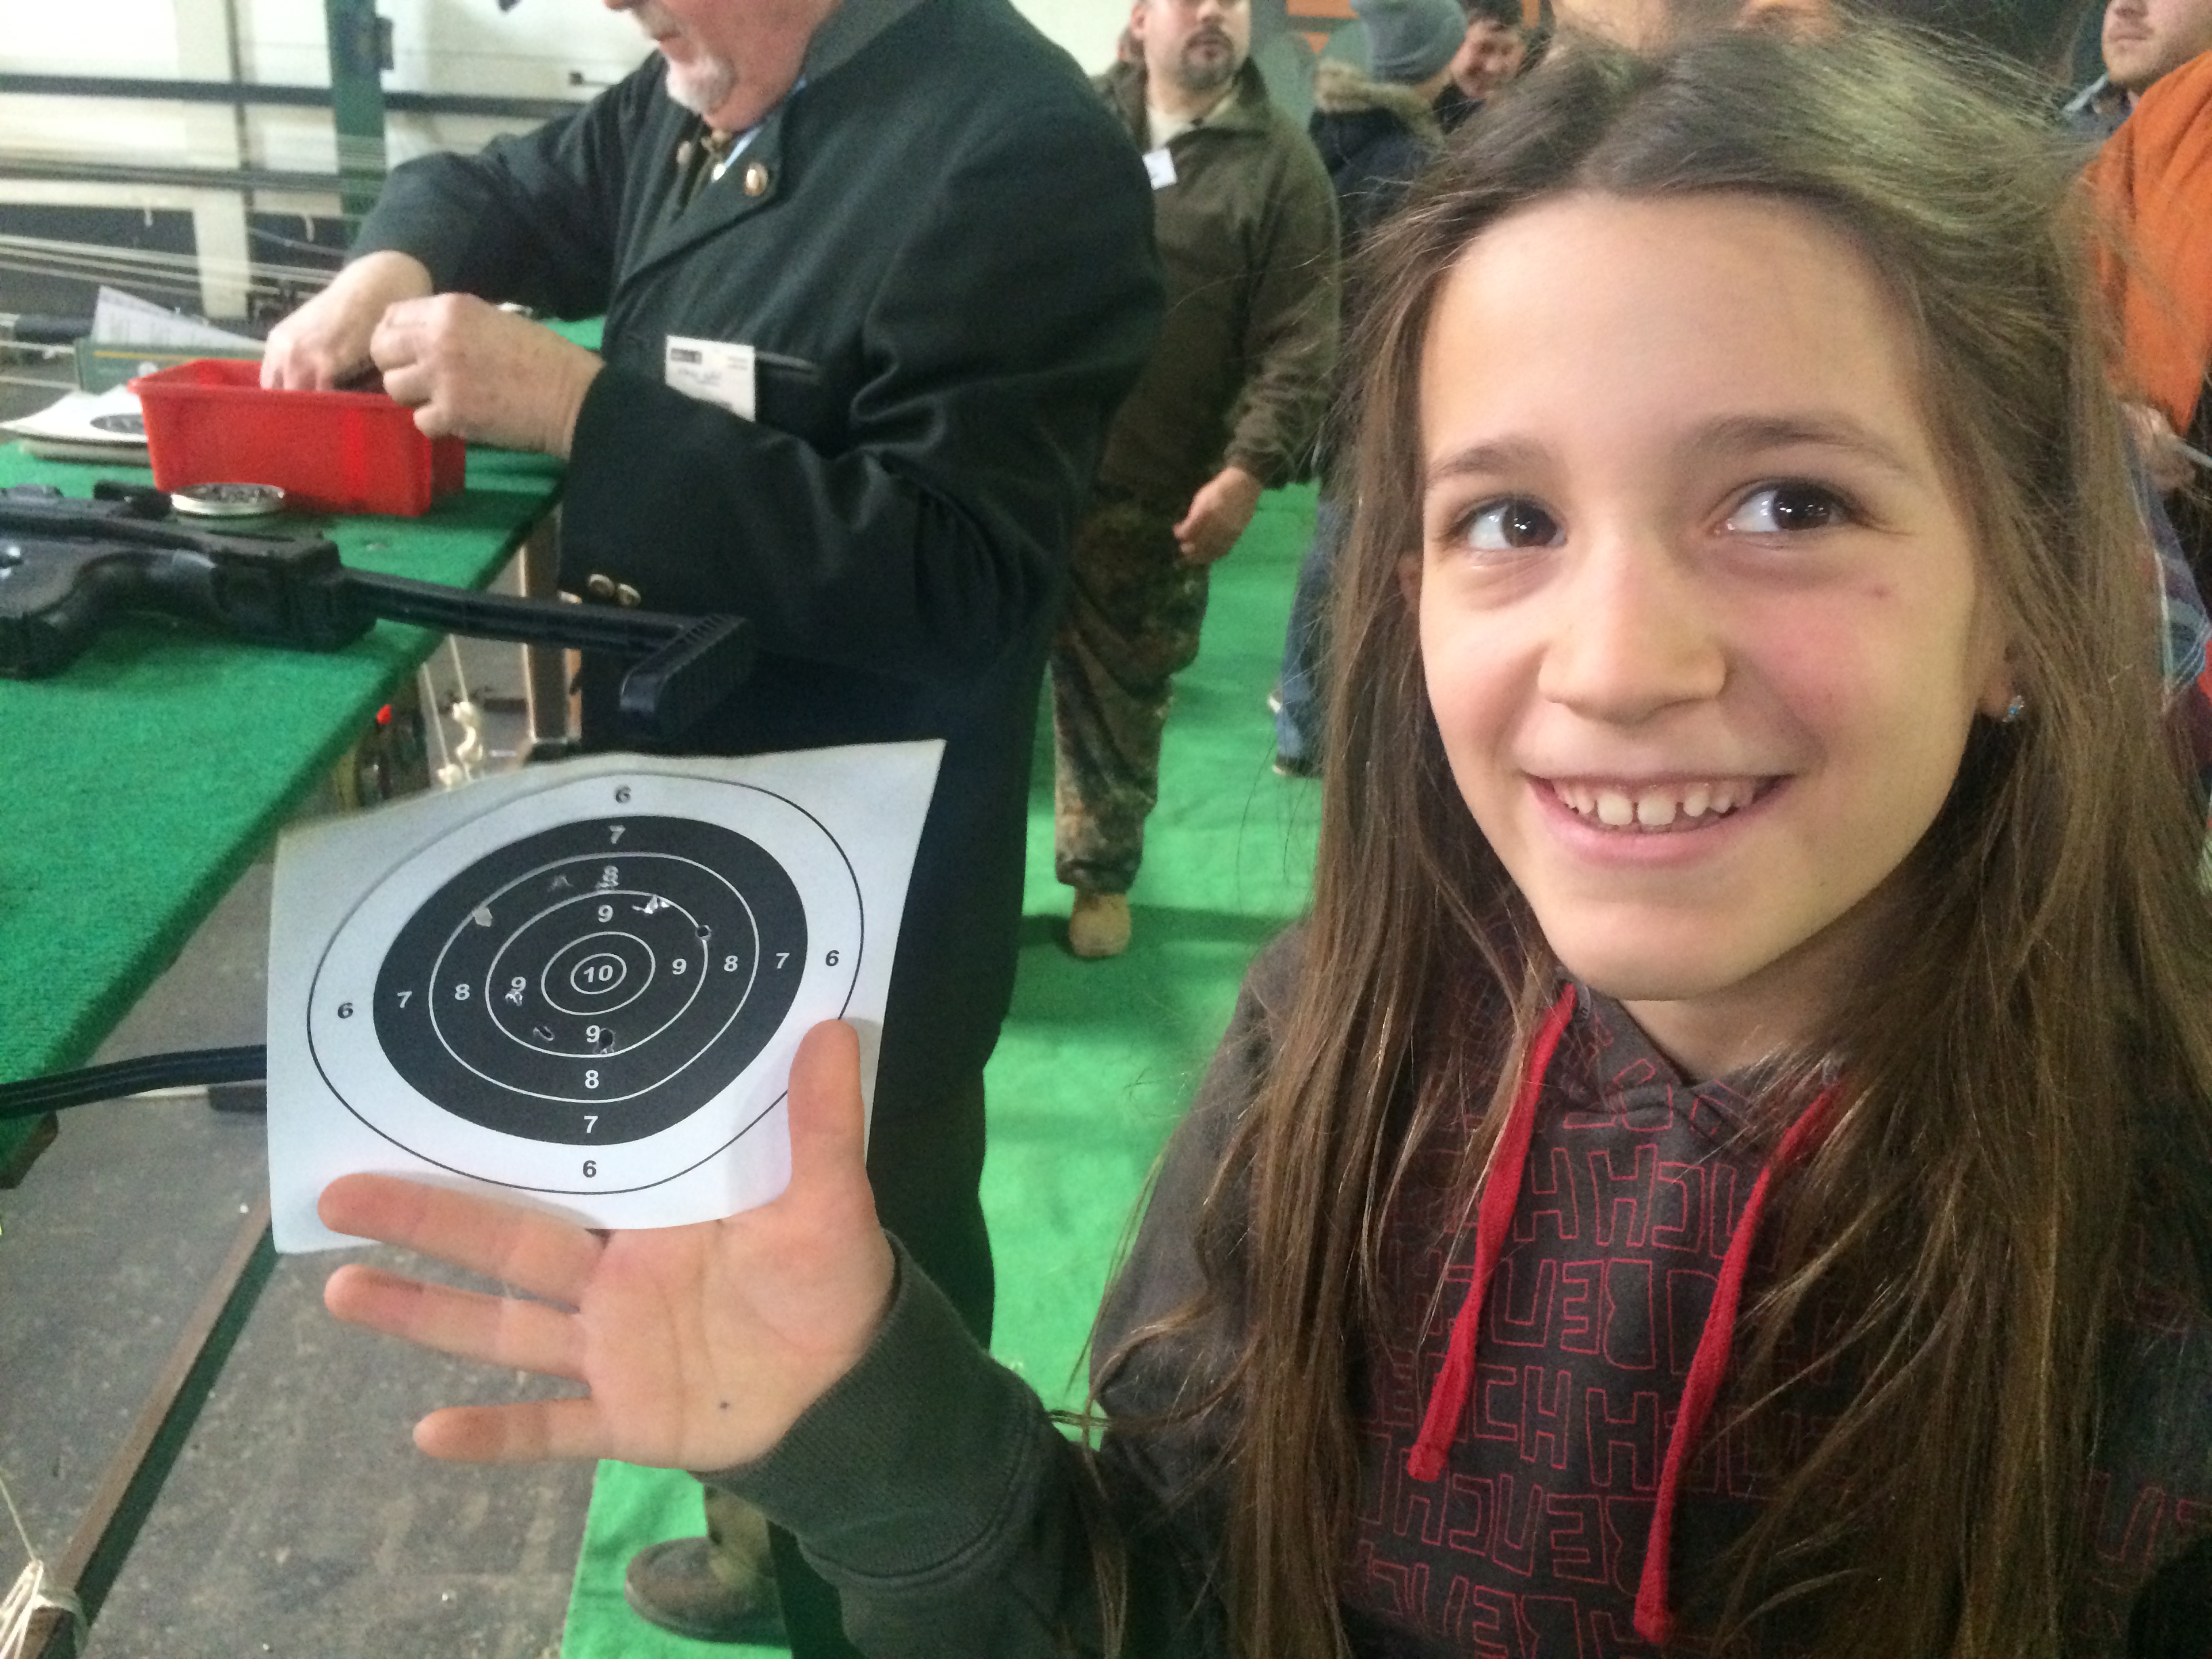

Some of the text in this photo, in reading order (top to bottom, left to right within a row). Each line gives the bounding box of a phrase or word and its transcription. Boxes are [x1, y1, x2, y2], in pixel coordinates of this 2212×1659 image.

[615, 785, 632, 804] 6
[609, 825, 626, 844] 7
[598, 905, 613, 922] 9
[337, 949, 840, 1019] 6 7 8 9 10 9 8 7 6
[586, 1025, 600, 1043] 9
[585, 1070, 600, 1088] 8
[583, 1115, 598, 1133] 7
[582, 1160, 597, 1179] 6
